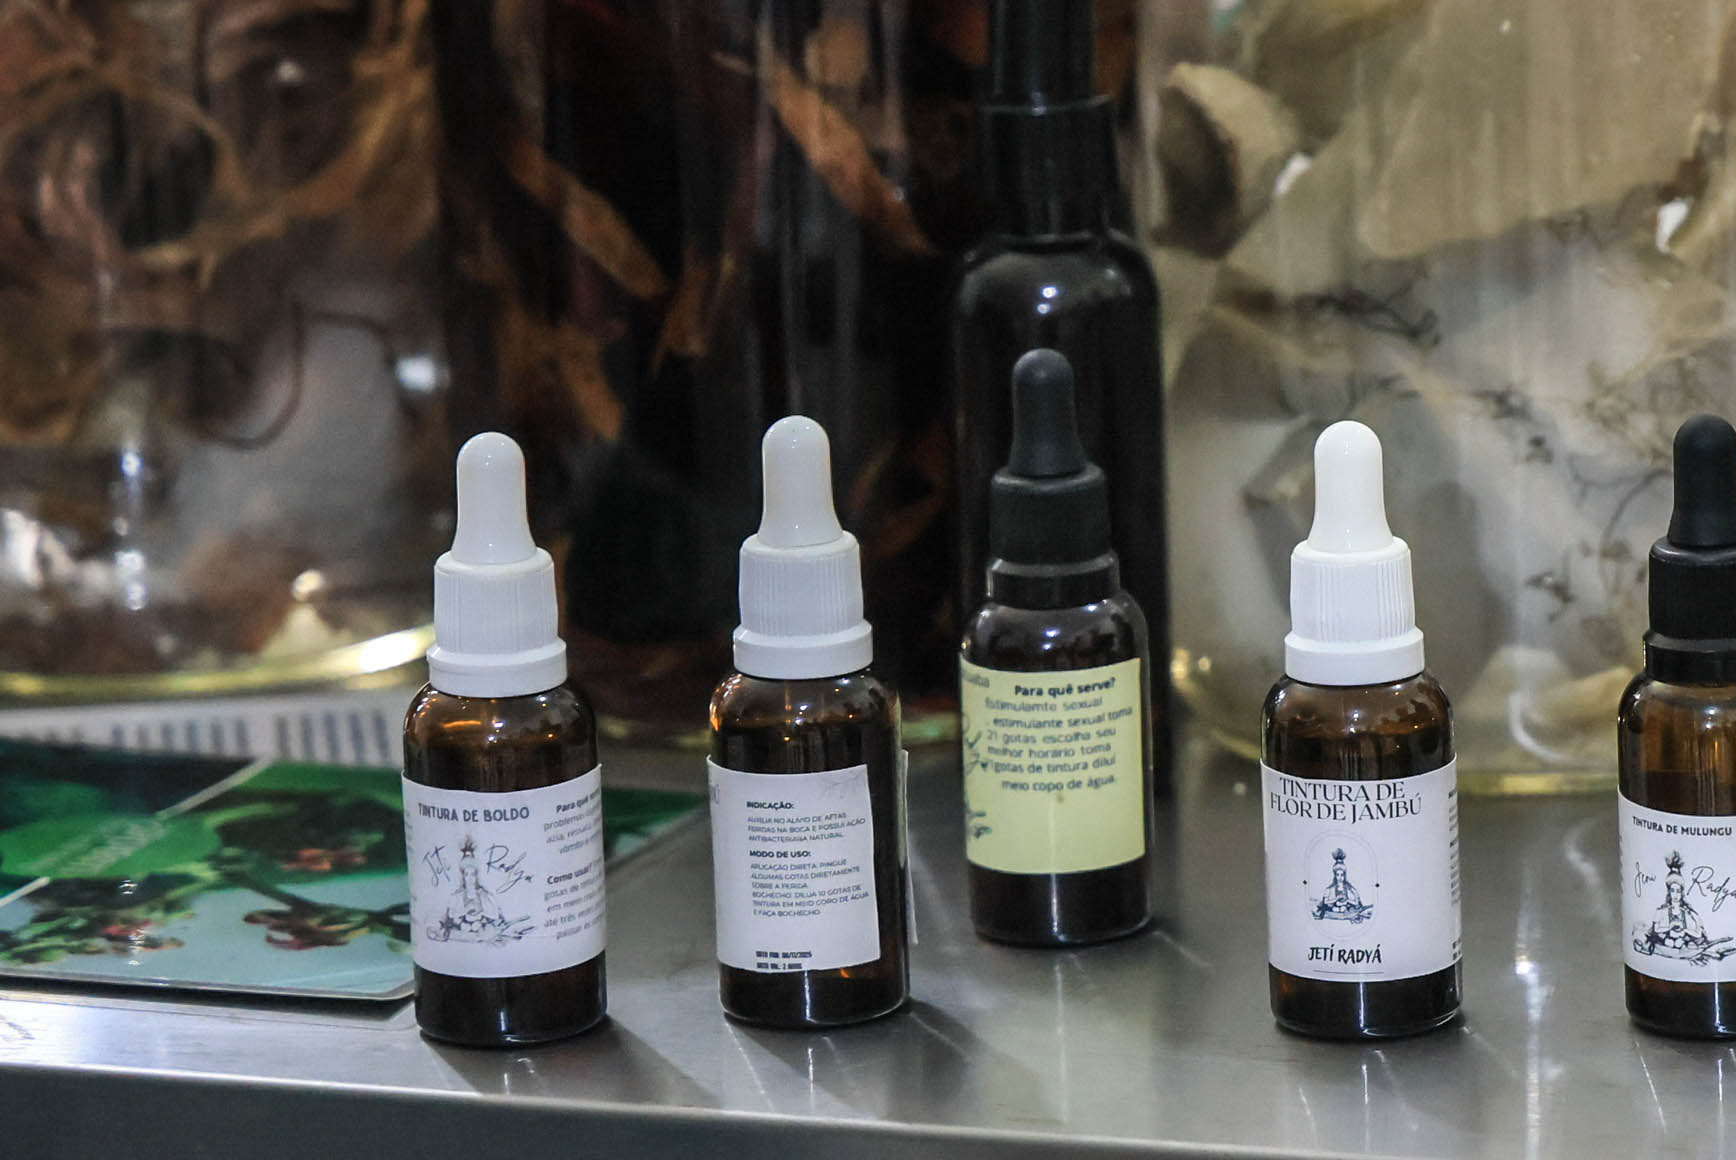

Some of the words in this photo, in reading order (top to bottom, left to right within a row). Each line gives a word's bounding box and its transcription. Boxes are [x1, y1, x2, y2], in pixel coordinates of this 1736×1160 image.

[1014, 685, 1044, 697] Para
[1047, 683, 1073, 698] quê
[1077, 676, 1117, 694] serve?
[1279, 777, 1371, 803] TINTURA
[1376, 782, 1406, 800] DE
[418, 802, 459, 822] TINTURA
[463, 809, 479, 822] DE
[483, 806, 530, 822] BOLDO
[1270, 791, 1313, 819] FLOR
[1317, 802, 1347, 821] DE
[1351, 791, 1423, 824] JAMBÚ
[1632, 815, 1664, 832] TINTURA
[1666, 824, 1678, 834] DE
[1681, 826, 1733, 836] MULUNGU
[749, 850, 775, 858] MODO
[776, 850, 788, 858] DE
[547, 872, 573, 885] Como
